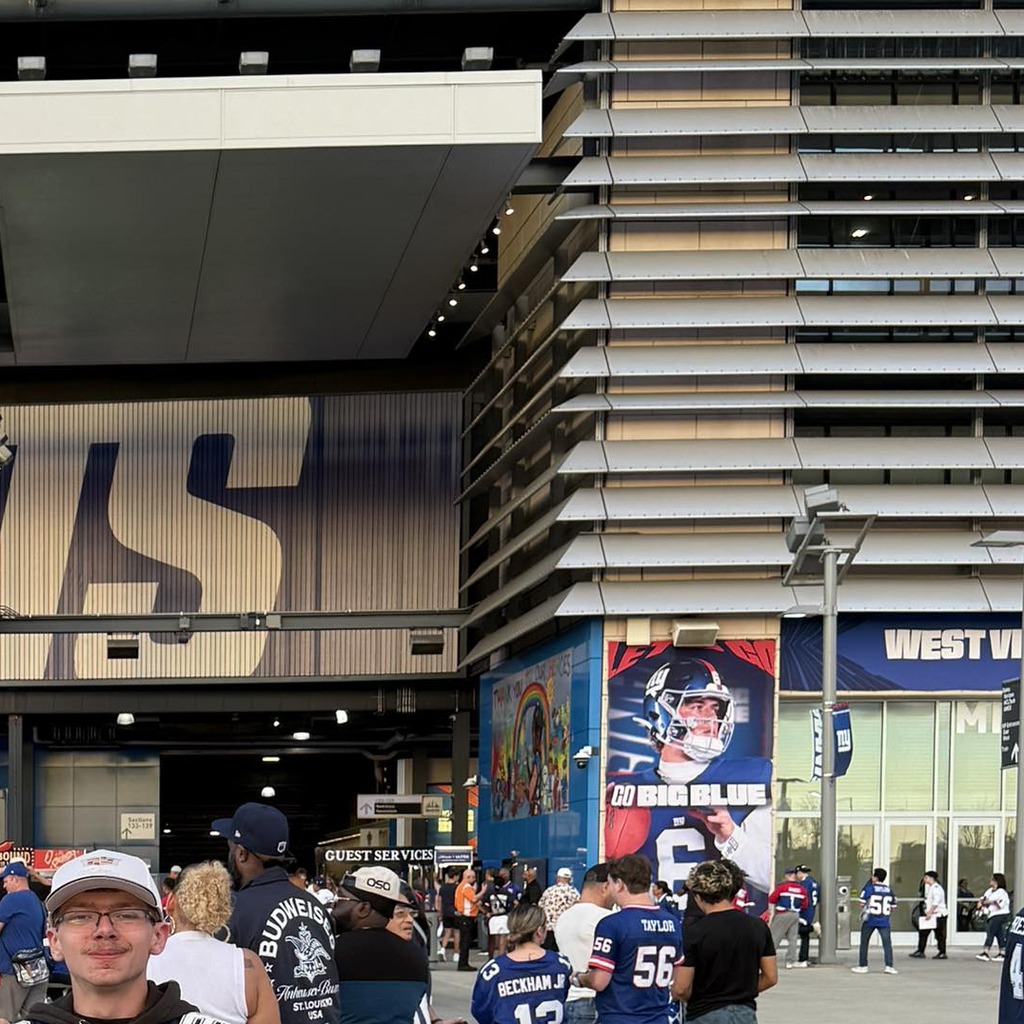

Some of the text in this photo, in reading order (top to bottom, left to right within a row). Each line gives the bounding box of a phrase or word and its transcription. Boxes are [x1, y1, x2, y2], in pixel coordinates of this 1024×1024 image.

[884, 629, 1023, 660] WEST VI
[611, 784, 767, 807] GO BIG BLUE
[325, 850, 371, 861] GUEST
[374, 849, 434, 861] SERVICES
[366, 877, 391, 891] OSO
[869, 895, 892, 916] 56
[641, 919, 675, 932] TAYLOR
[593, 936, 613, 953] 56
[633, 945, 676, 988] 56
[497, 973, 566, 998] BECKHAM JR
[307, 1010, 323, 1020] USA
